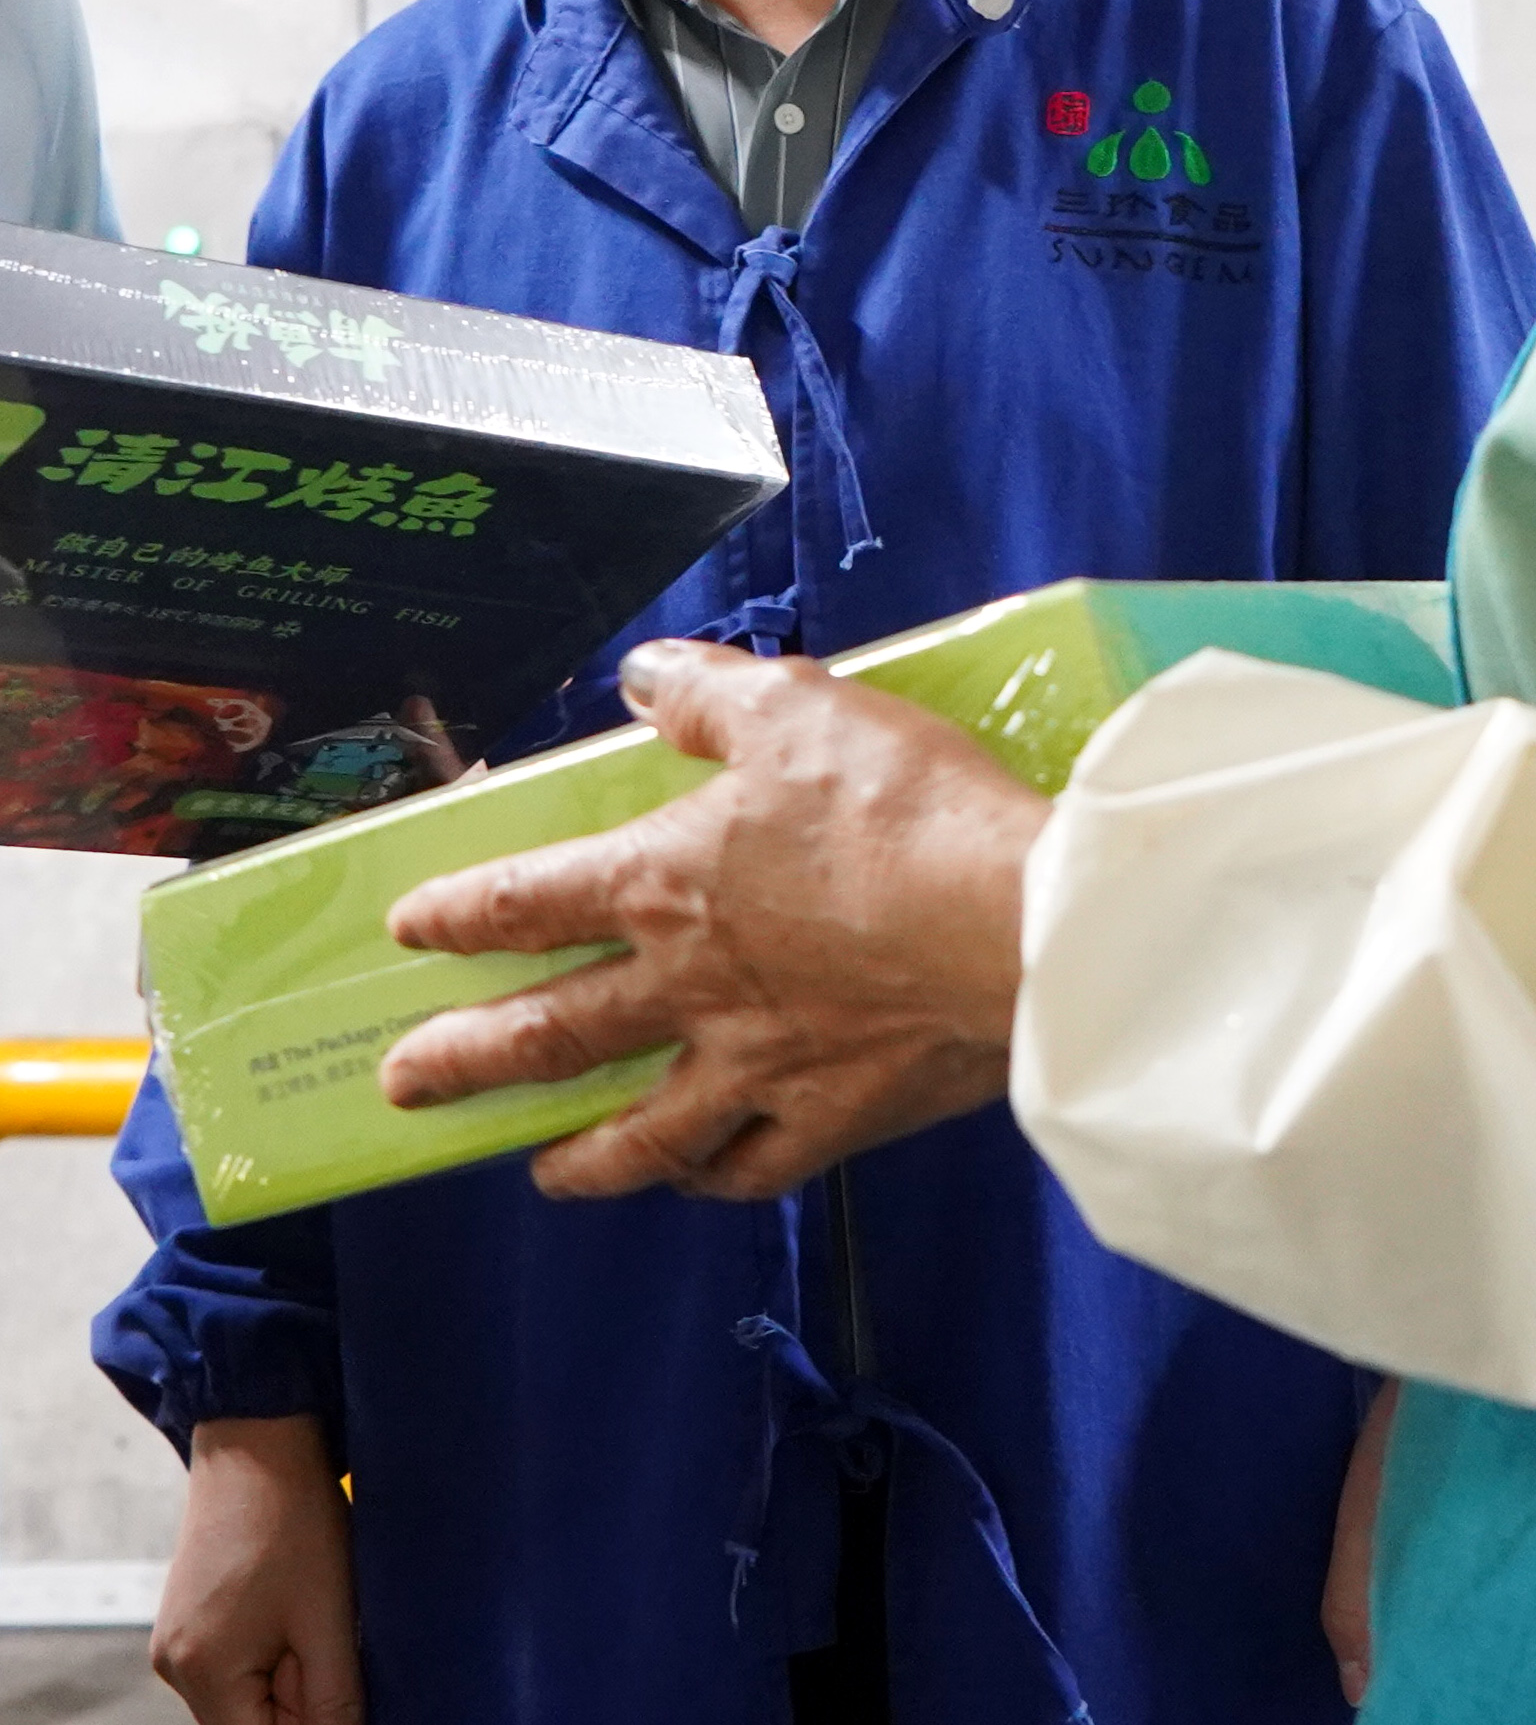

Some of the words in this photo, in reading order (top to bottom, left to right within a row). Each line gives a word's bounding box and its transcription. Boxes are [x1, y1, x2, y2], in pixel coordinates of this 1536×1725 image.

[1052, 186, 1252, 232] 三珍食品
[25, 558, 144, 584] MASTER
[172, 576, 215, 592] OF
[237, 584, 373, 615] GRILLING
[393, 607, 462, 629] FISH
